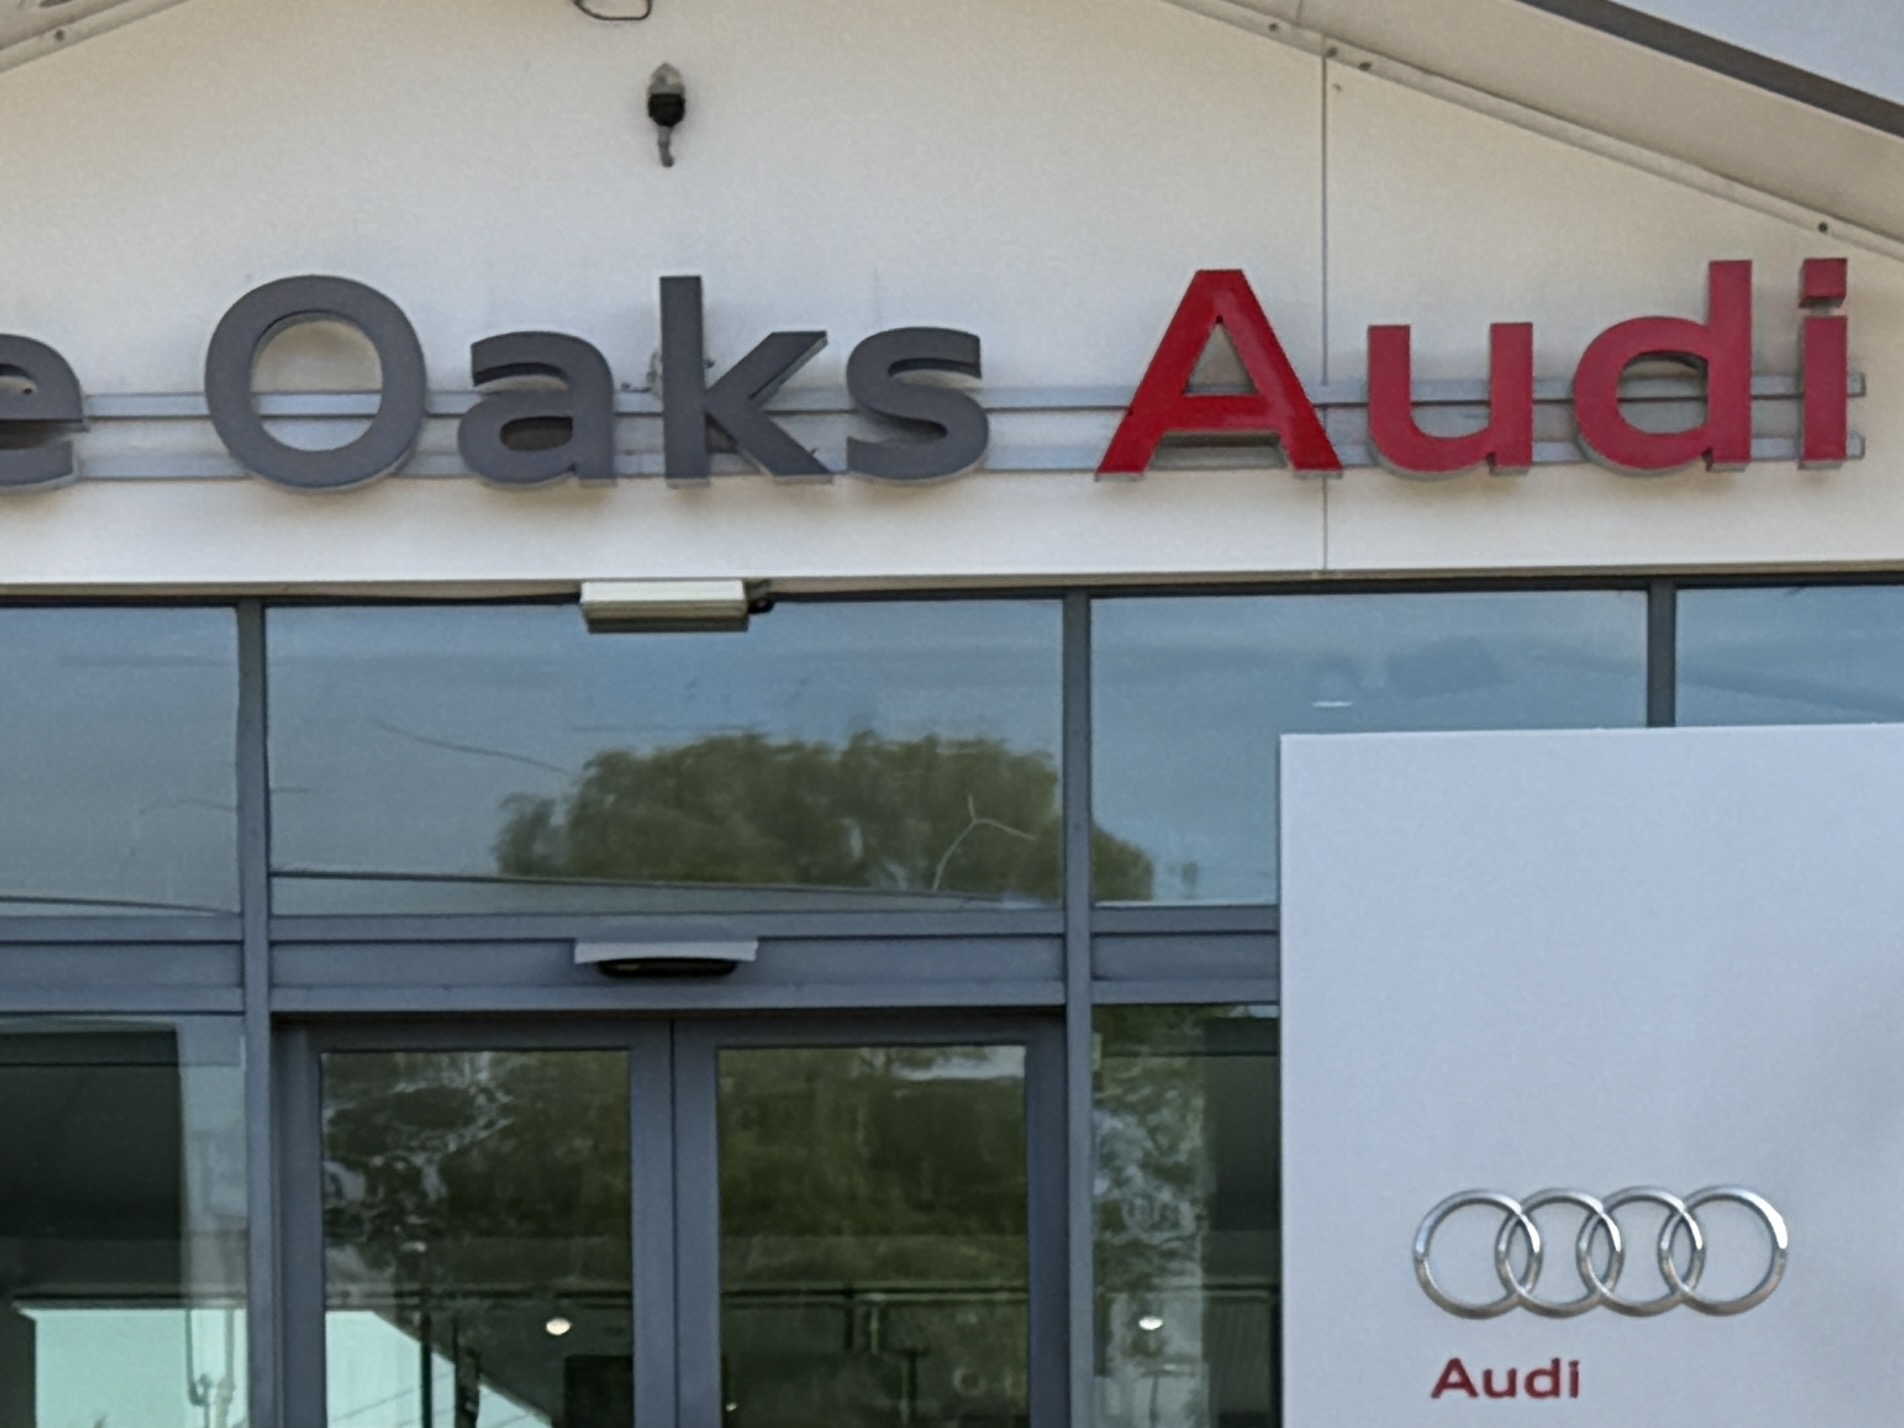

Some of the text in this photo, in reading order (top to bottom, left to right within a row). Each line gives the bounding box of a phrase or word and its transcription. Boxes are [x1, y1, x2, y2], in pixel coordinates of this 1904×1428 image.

[203, 273, 990, 491] Oaks
[1096, 258, 1848, 478] Audi
[1430, 1356, 1581, 1399] Audi
